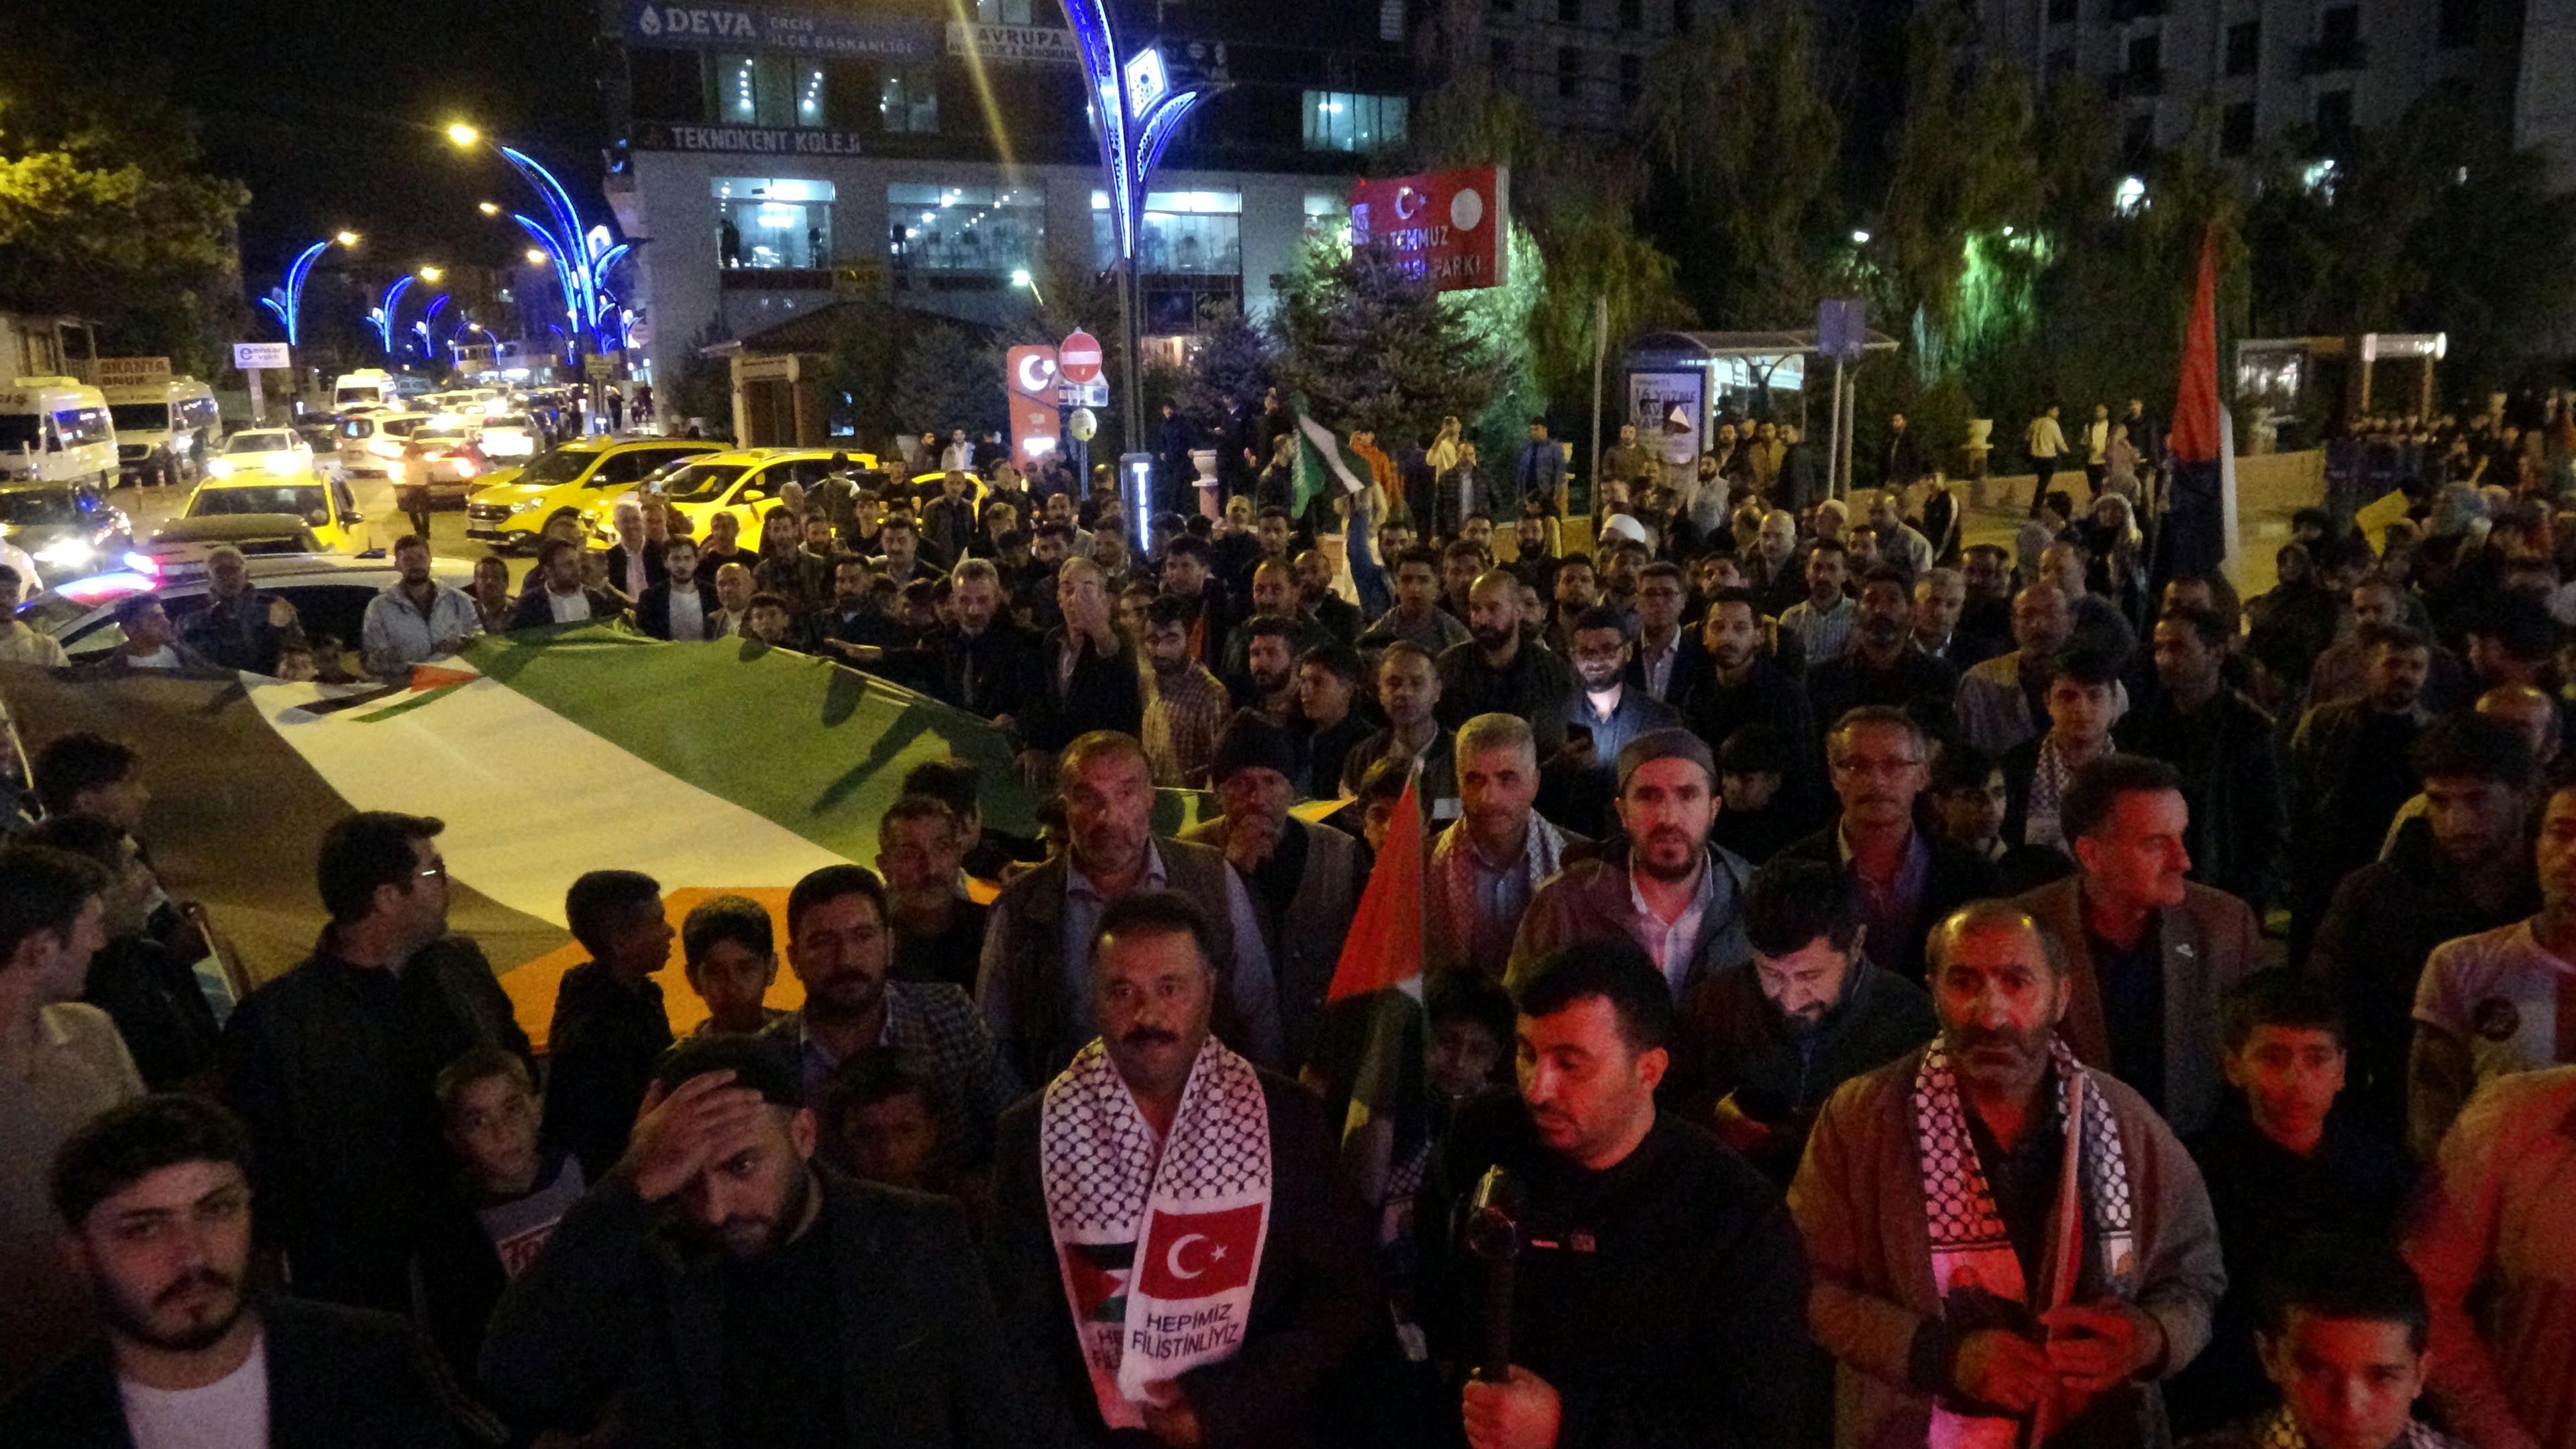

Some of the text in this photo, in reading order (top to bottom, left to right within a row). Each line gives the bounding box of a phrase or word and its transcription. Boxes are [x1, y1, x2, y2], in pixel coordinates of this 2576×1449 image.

[665, 7, 757, 38] DEVA
[978, 28, 1062, 47] AVRUPA
[671, 127, 788, 152] TEKNOKENT
[1390, 225, 1449, 250] TEMMUZ
[1146, 1303, 1233, 1334] HEPİMİZ
